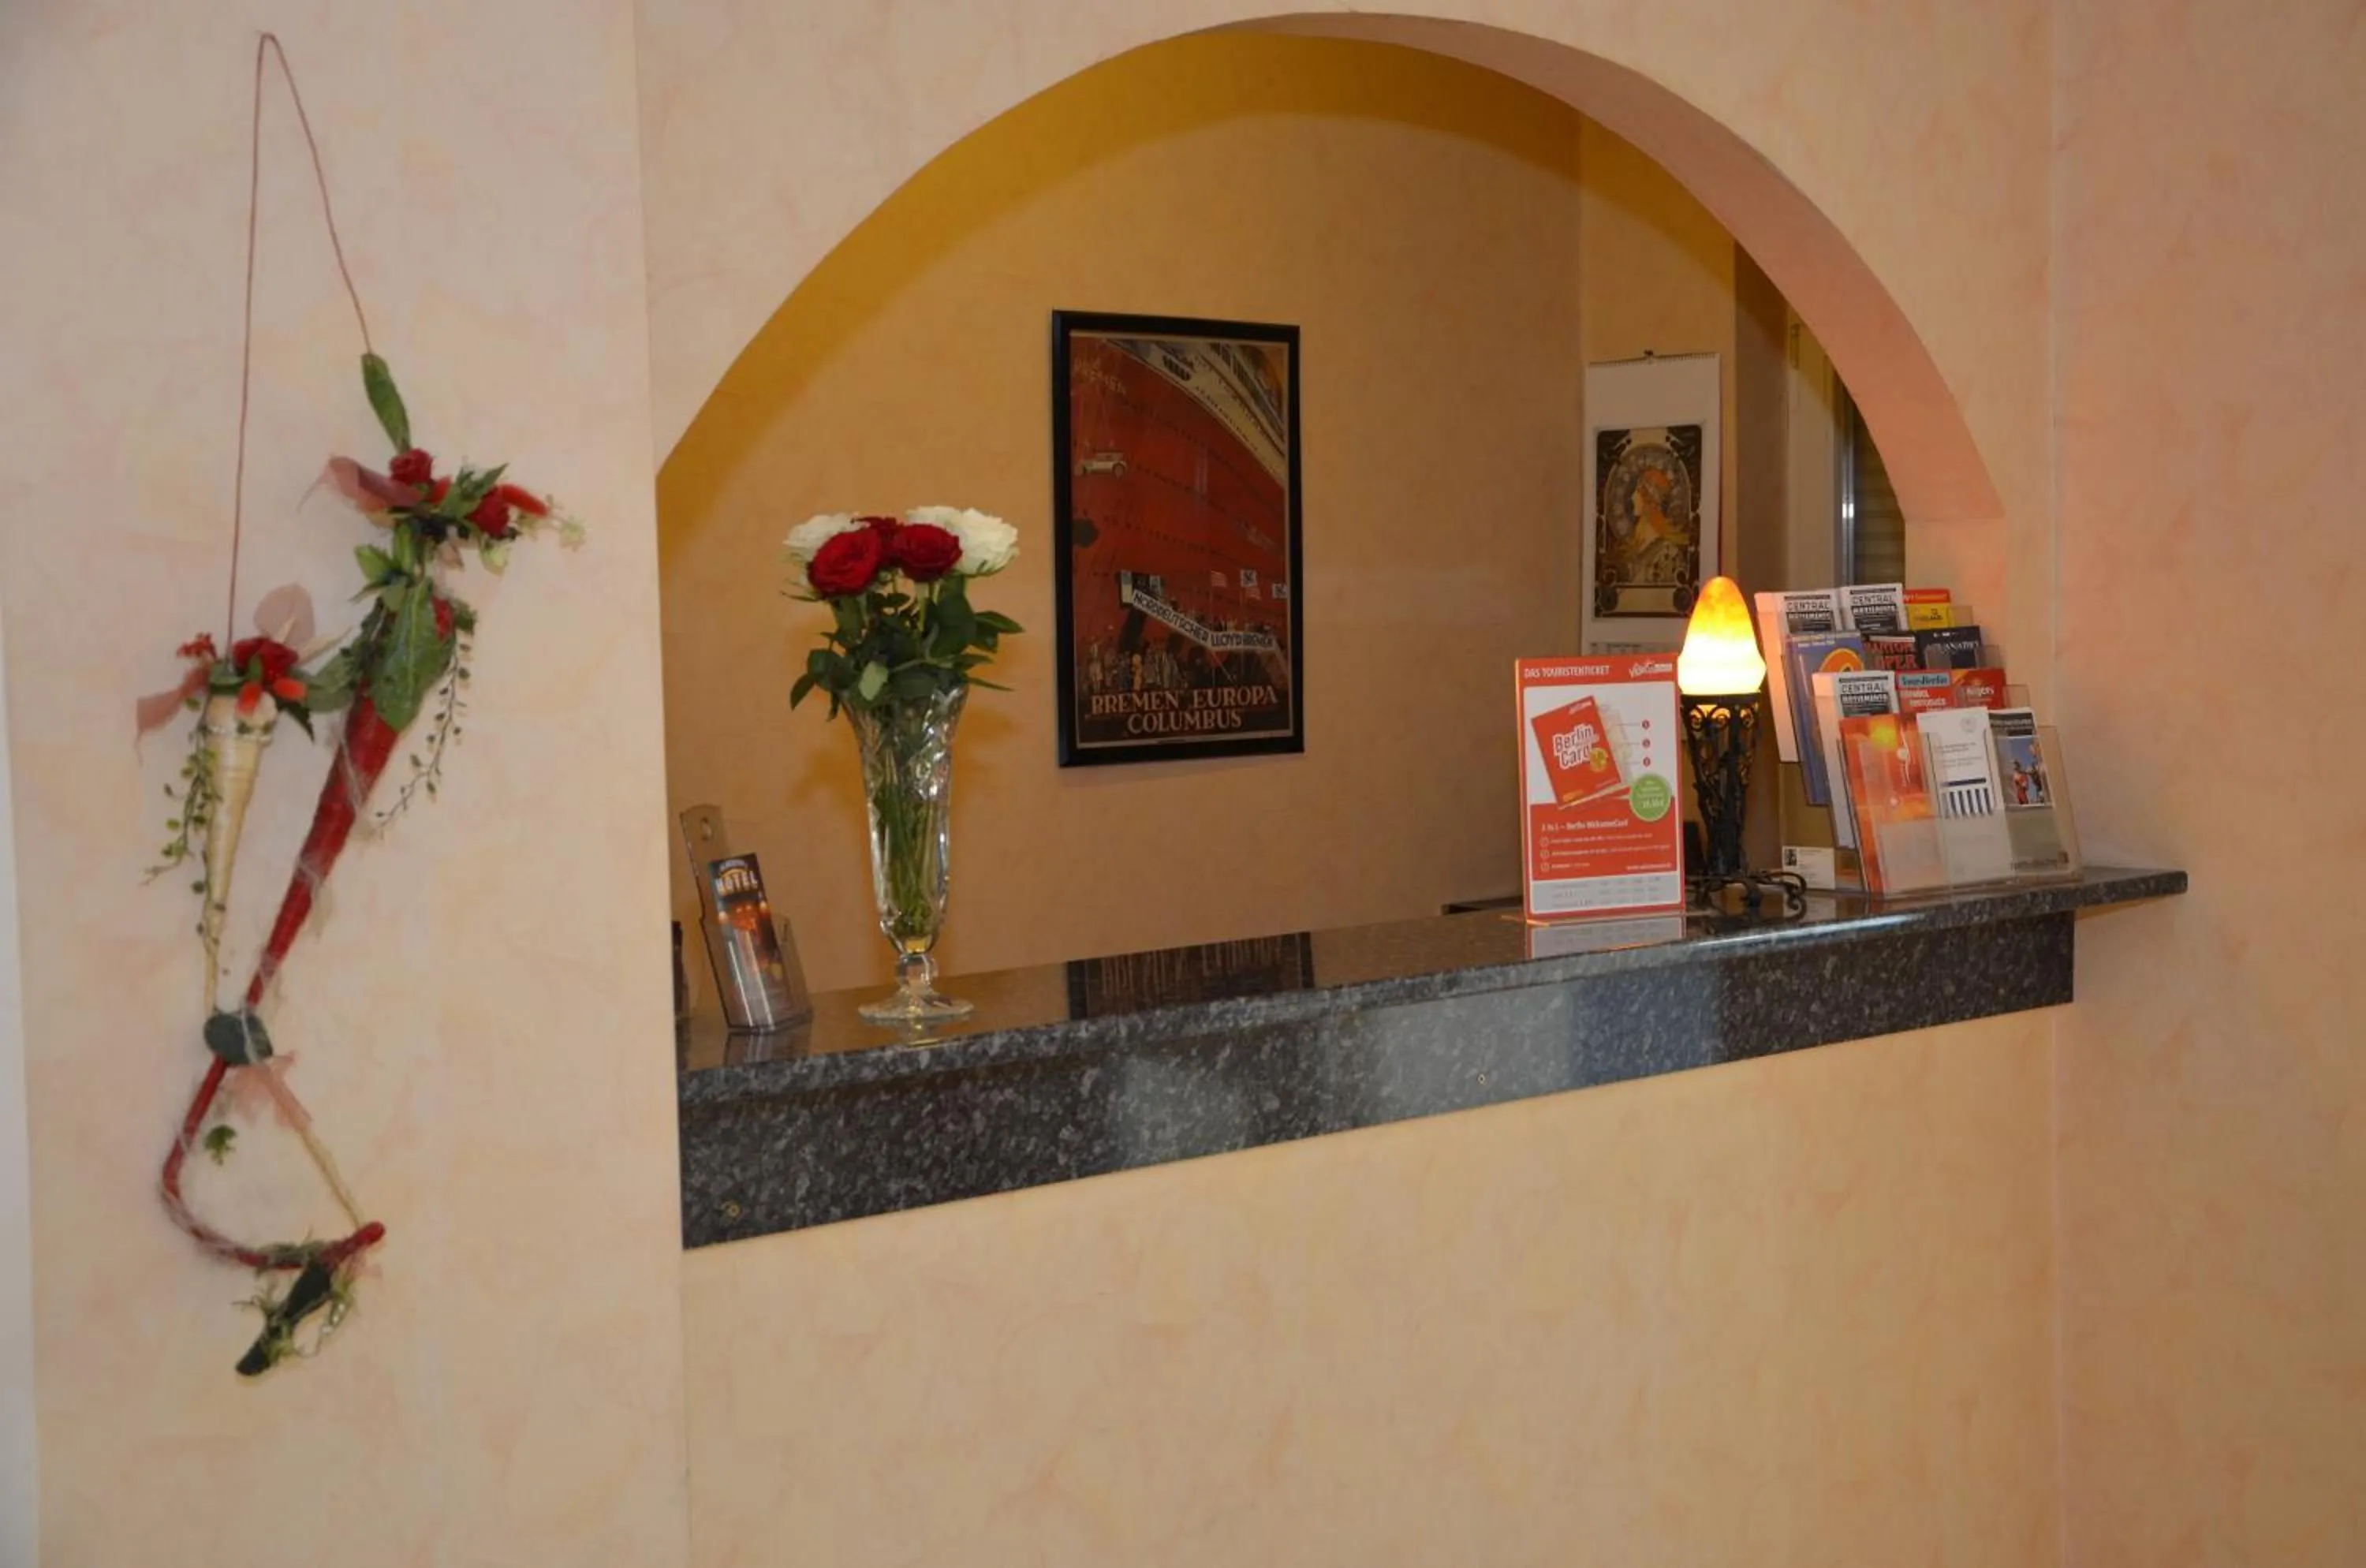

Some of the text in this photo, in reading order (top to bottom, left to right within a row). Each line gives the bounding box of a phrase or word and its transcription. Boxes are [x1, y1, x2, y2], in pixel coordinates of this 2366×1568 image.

[1786, 602, 1830, 611] CENTRAL
[1852, 594, 1894, 606] CENTRAL
[1192, 685, 1278, 709] EUROPA
[1842, 683, 1885, 693] CENTRAL
[1127, 708, 1242, 734] COLUMBUS
[1554, 726, 1594, 753] Berlin
[715, 870, 758, 894] HOTEL
